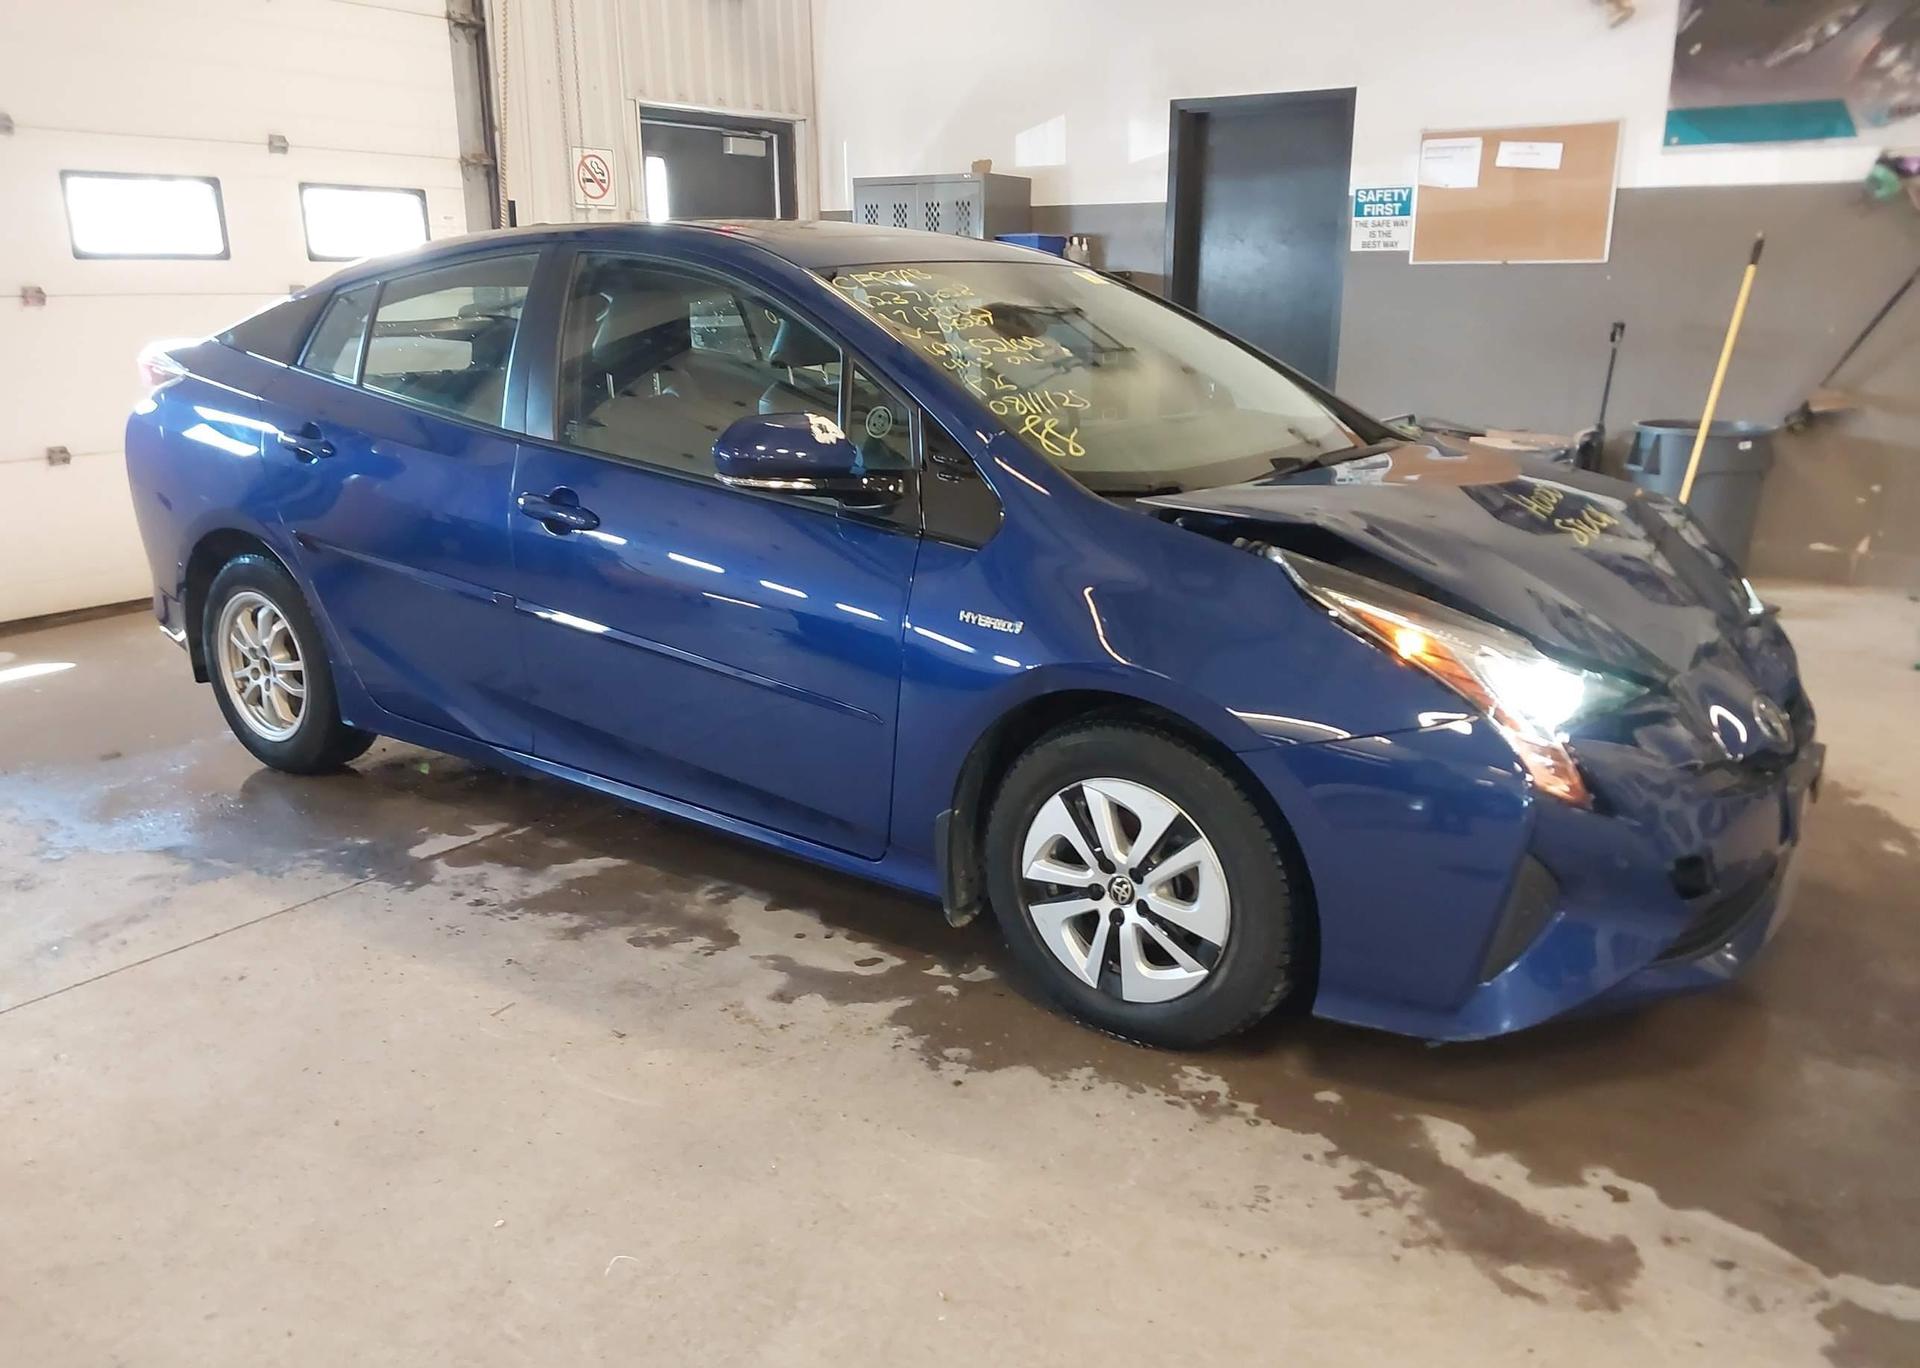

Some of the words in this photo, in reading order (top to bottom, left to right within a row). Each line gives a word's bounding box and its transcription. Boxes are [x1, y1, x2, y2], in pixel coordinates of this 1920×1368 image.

[1356, 188, 1410, 203] SAFETY
[1363, 203, 1403, 216] FIRST
[1355, 220, 1369, 228] THE
[1371, 219, 1392, 228] SAFE
[1392, 219, 1409, 228] WAY
[1368, 230, 1377, 238] IS
[1377, 230, 1392, 238] THE
[1361, 241, 1381, 249] BEST
[1382, 240, 1399, 249] WAY
